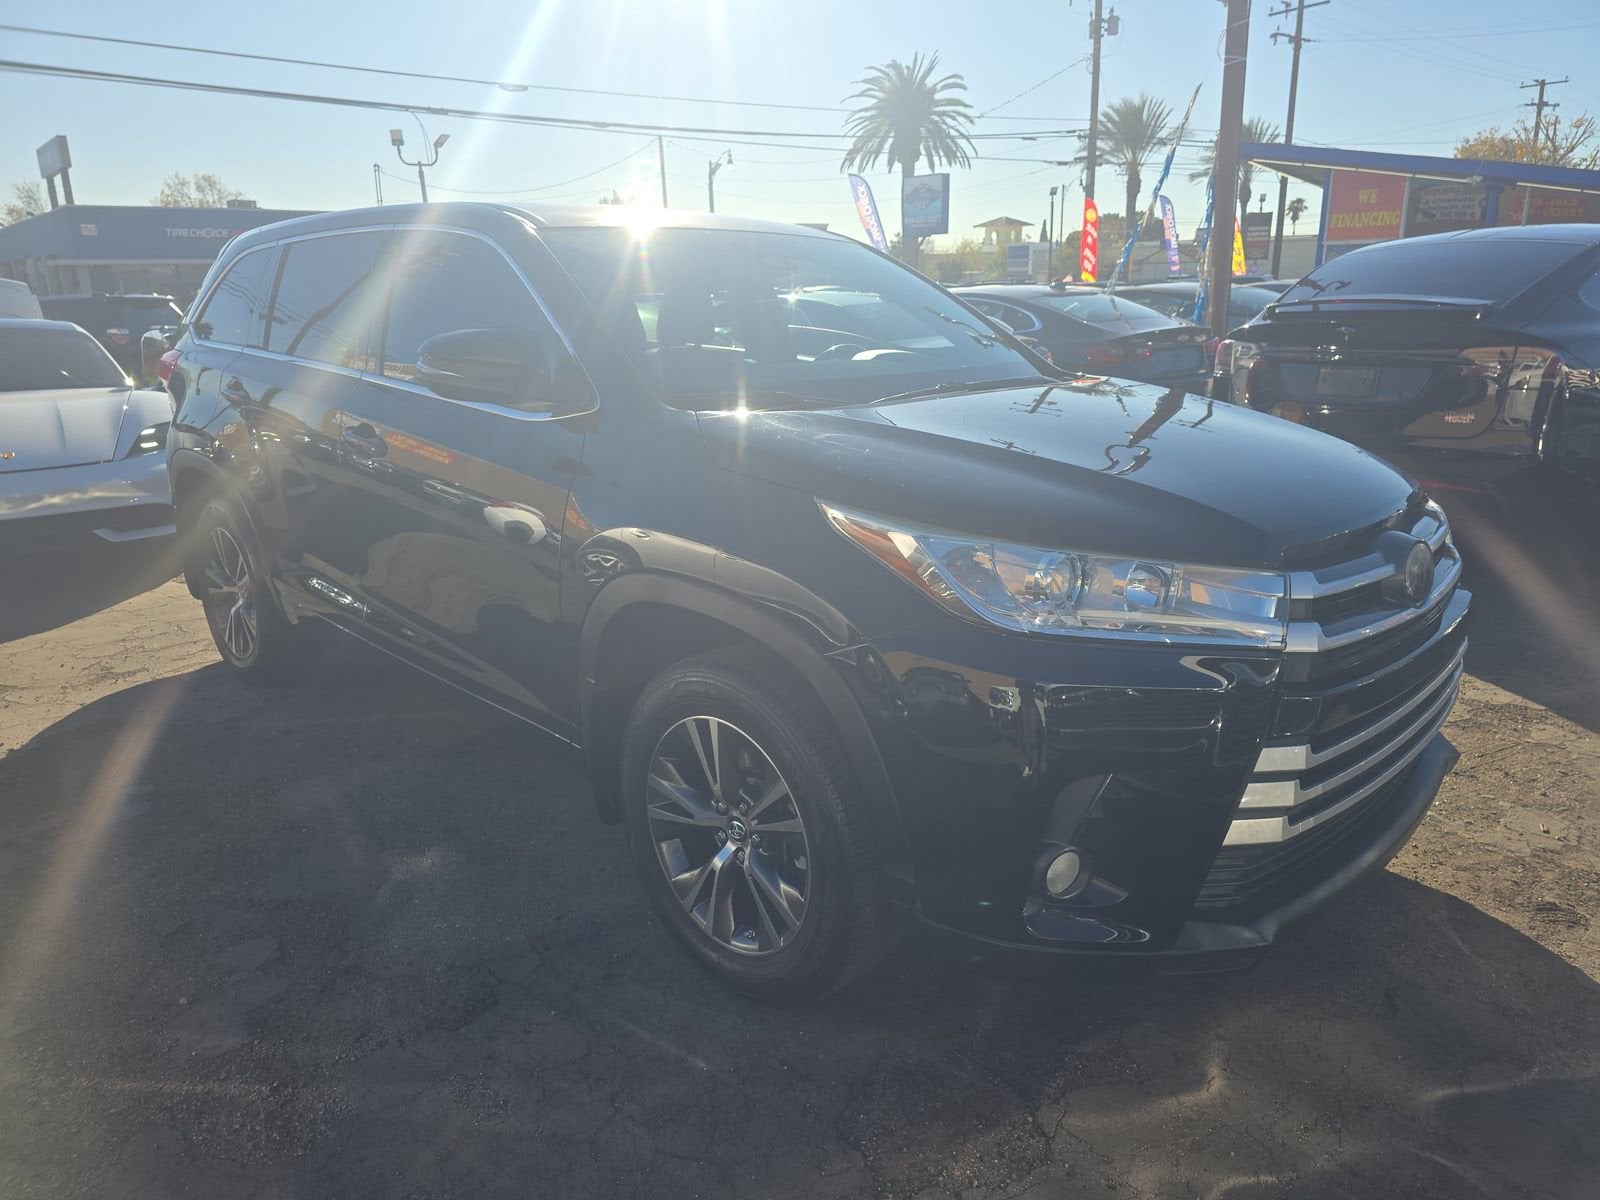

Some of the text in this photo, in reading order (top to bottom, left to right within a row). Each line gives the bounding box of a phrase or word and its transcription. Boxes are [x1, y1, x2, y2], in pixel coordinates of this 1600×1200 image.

[856, 185, 873, 215] CHECK
[1359, 188, 1378, 204] WE
[1330, 210, 1401, 228] FINANCING
